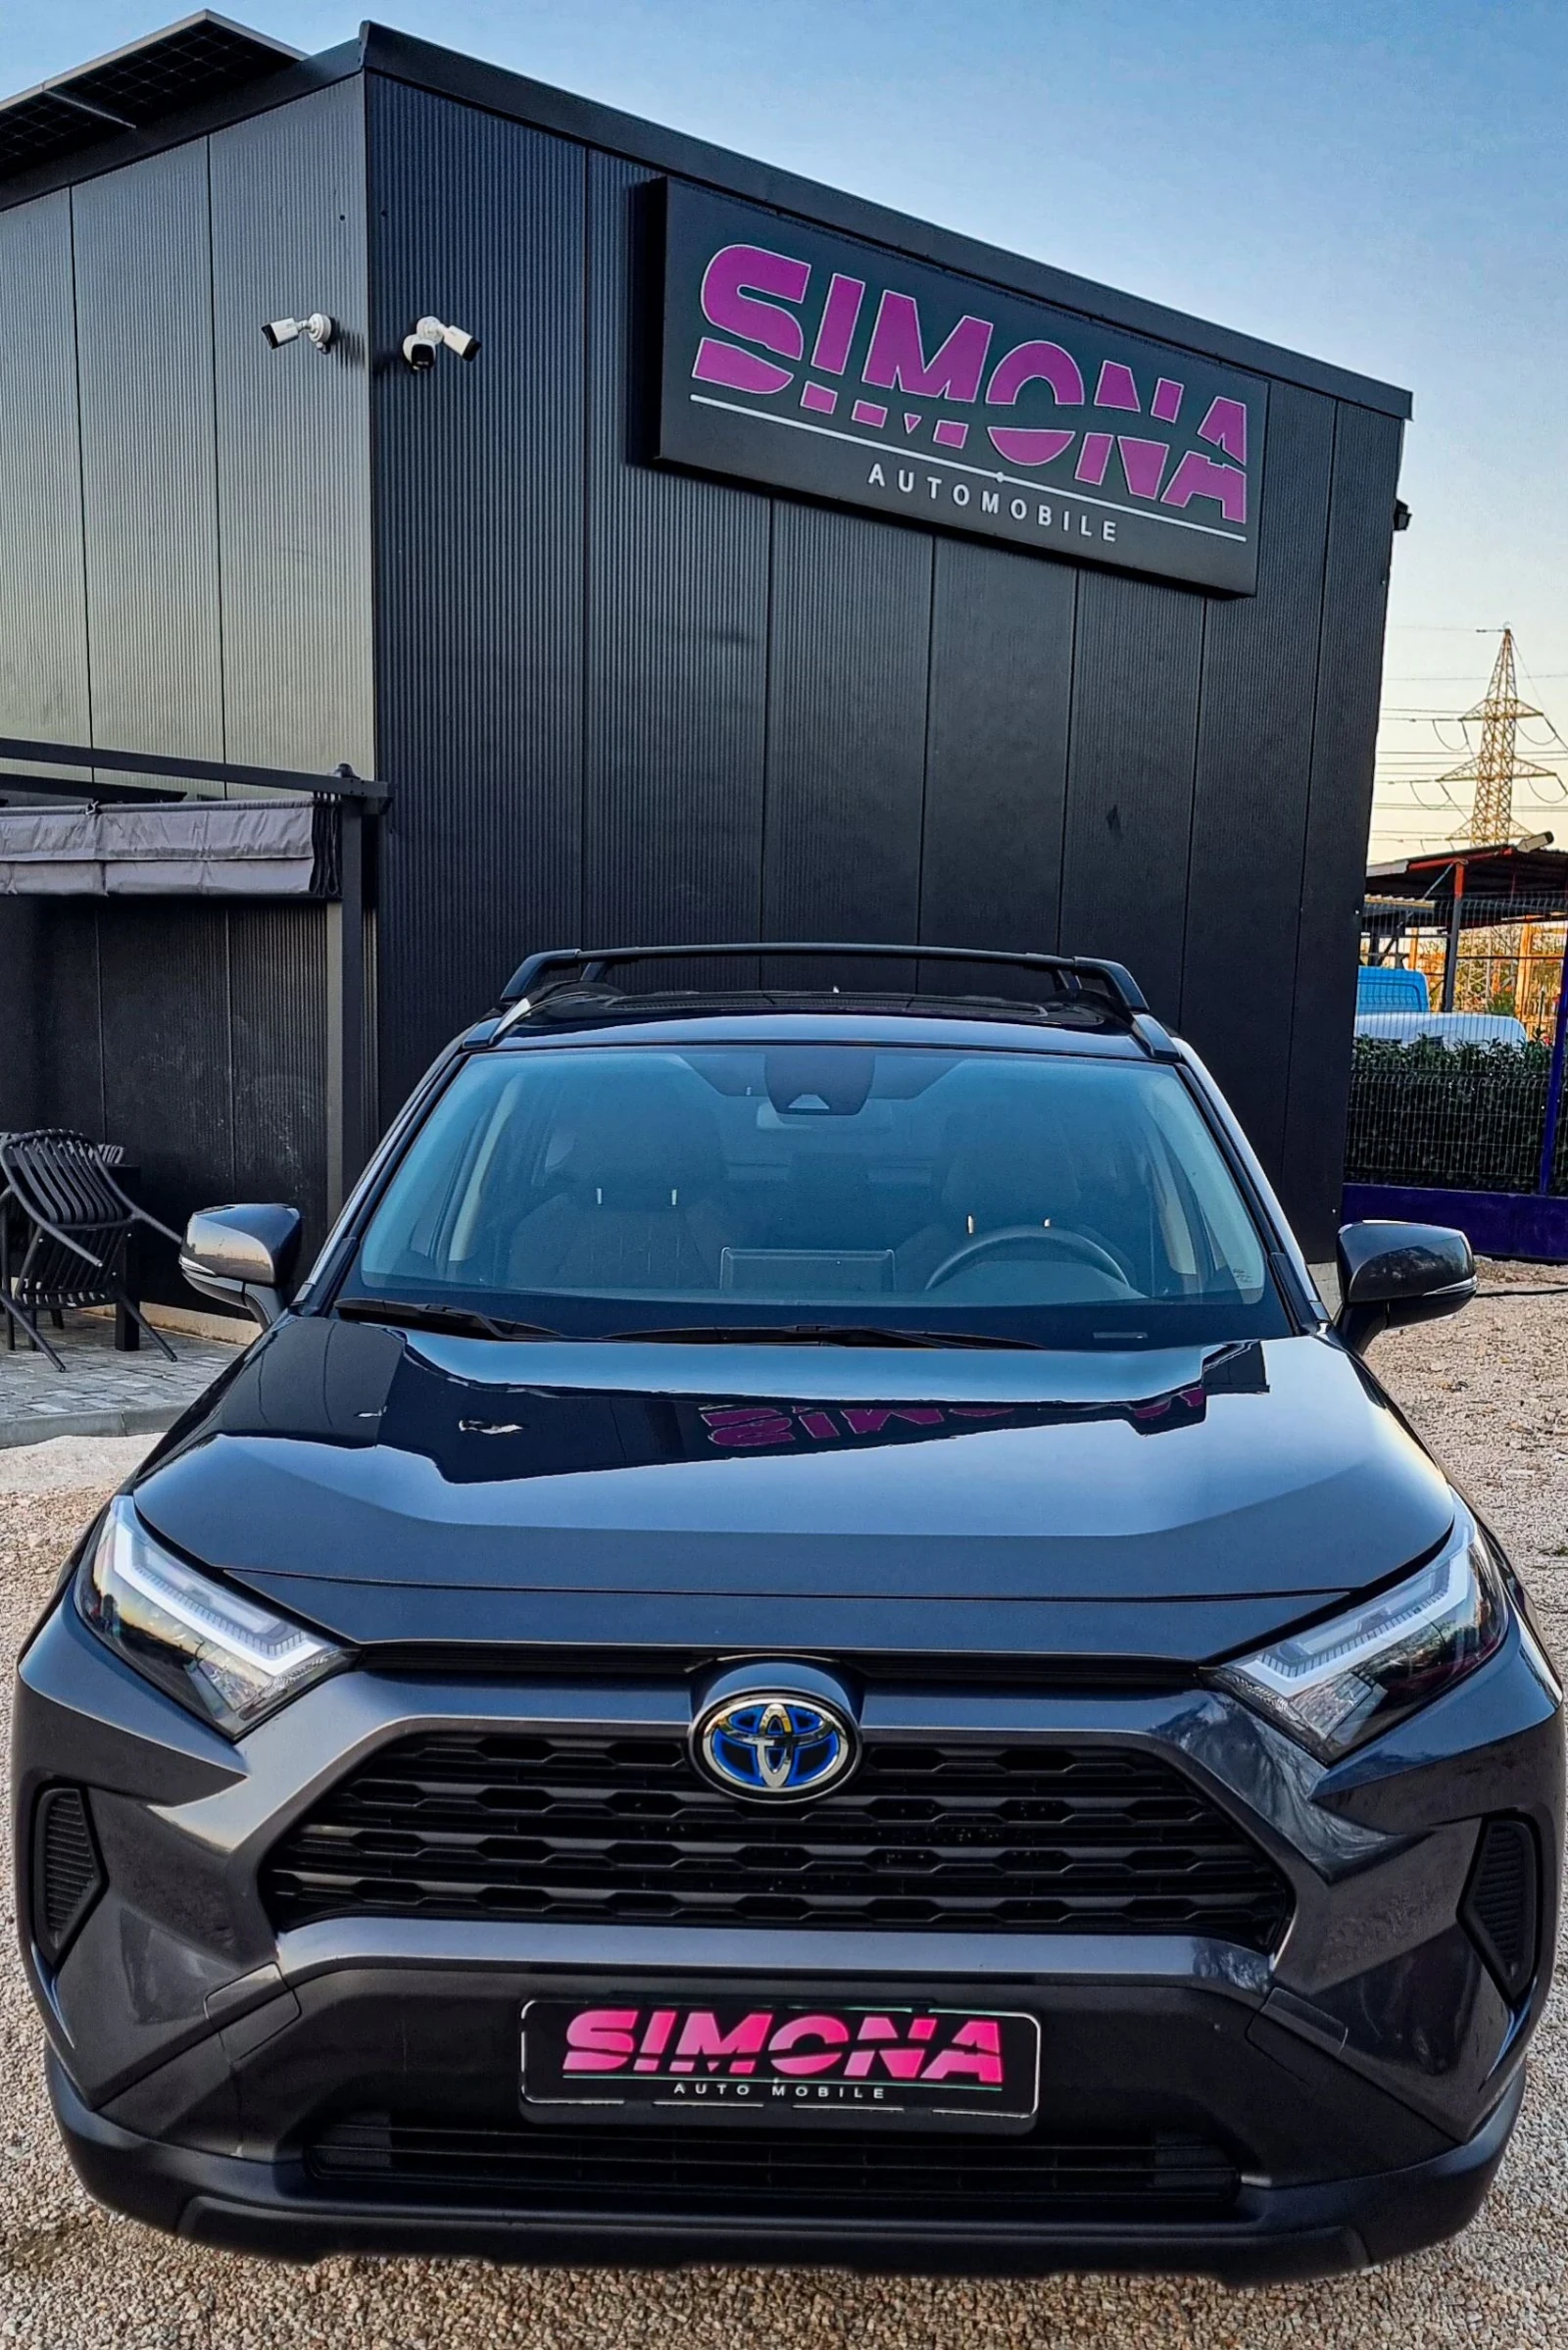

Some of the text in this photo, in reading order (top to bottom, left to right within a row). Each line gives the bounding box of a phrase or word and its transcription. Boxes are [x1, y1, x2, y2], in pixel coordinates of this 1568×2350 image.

[692, 244, 1247, 523] SIMONA
[868, 463, 1118, 542] AUTOMOBILE
[563, 2009, 1003, 2083] SIMONA
